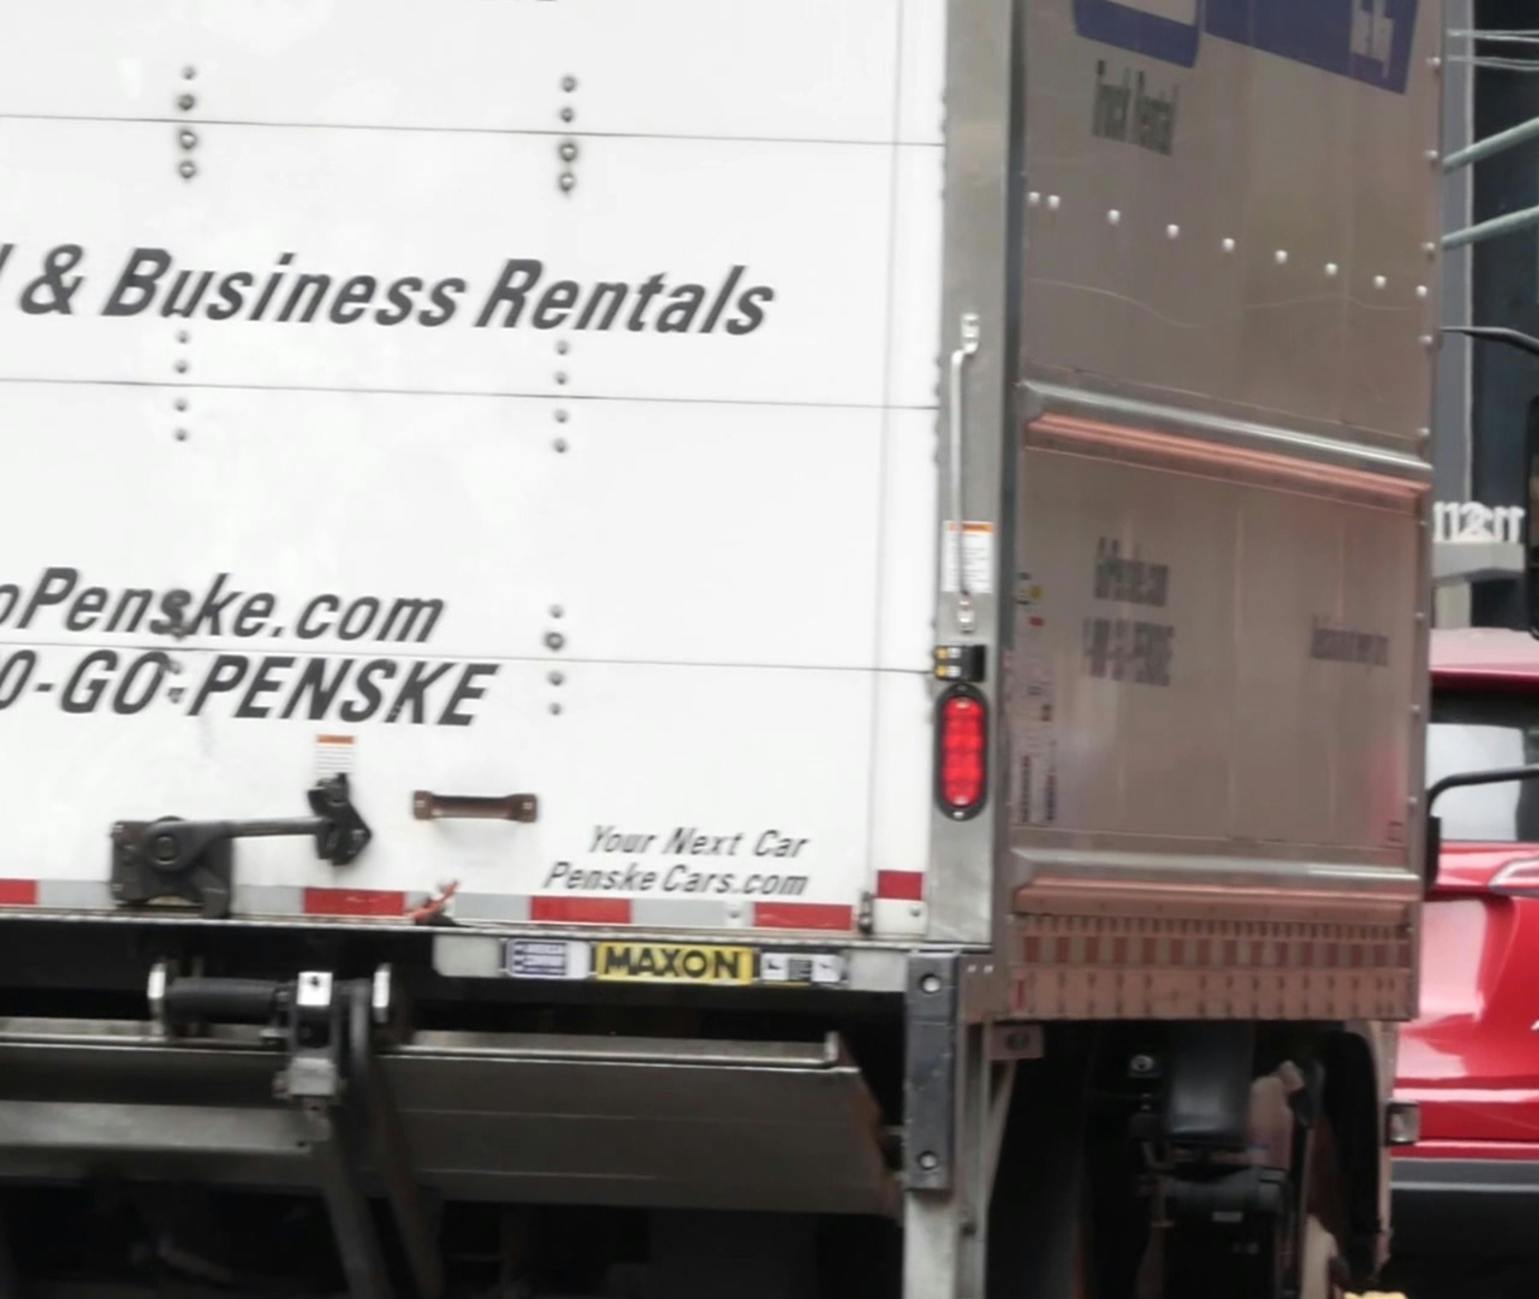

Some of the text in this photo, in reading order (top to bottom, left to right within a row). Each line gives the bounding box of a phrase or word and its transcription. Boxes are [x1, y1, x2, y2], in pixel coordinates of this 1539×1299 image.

[19, 243, 84, 315] &
[101, 247, 467, 328] Business
[472, 257, 775, 336] Rentals
[588, 825, 809, 858] Your Next Car
[604, 946, 742, 980] MAXON
